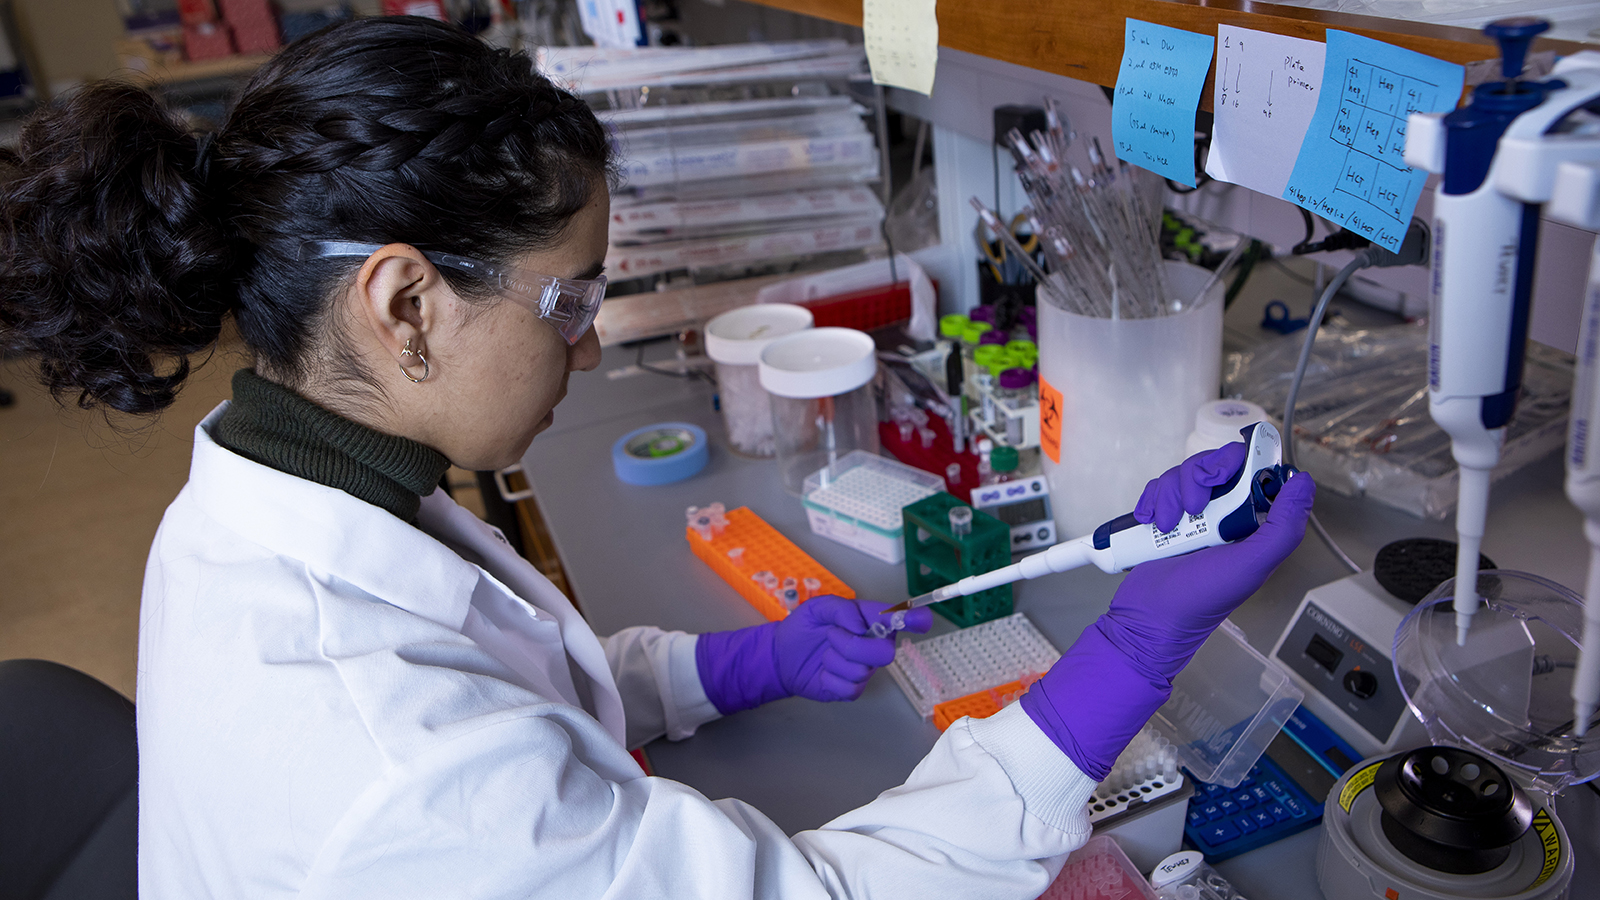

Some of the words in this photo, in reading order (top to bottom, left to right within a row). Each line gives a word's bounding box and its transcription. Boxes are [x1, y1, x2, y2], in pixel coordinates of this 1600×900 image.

[1131, 29, 1136, 41] 5
[1224, 35, 1231, 49] 1
[1239, 41, 1244, 52] 9
[1128, 57, 1133, 67] 2
[1345, 165, 1365, 188] HCT
[1377, 186, 1399, 206] HCT
[1305, 605, 1345, 640] CORNING
[1350, 639, 1365, 654] LSE
[1239, 793, 1250, 801] 9
[1205, 806, 1217, 814] 3
